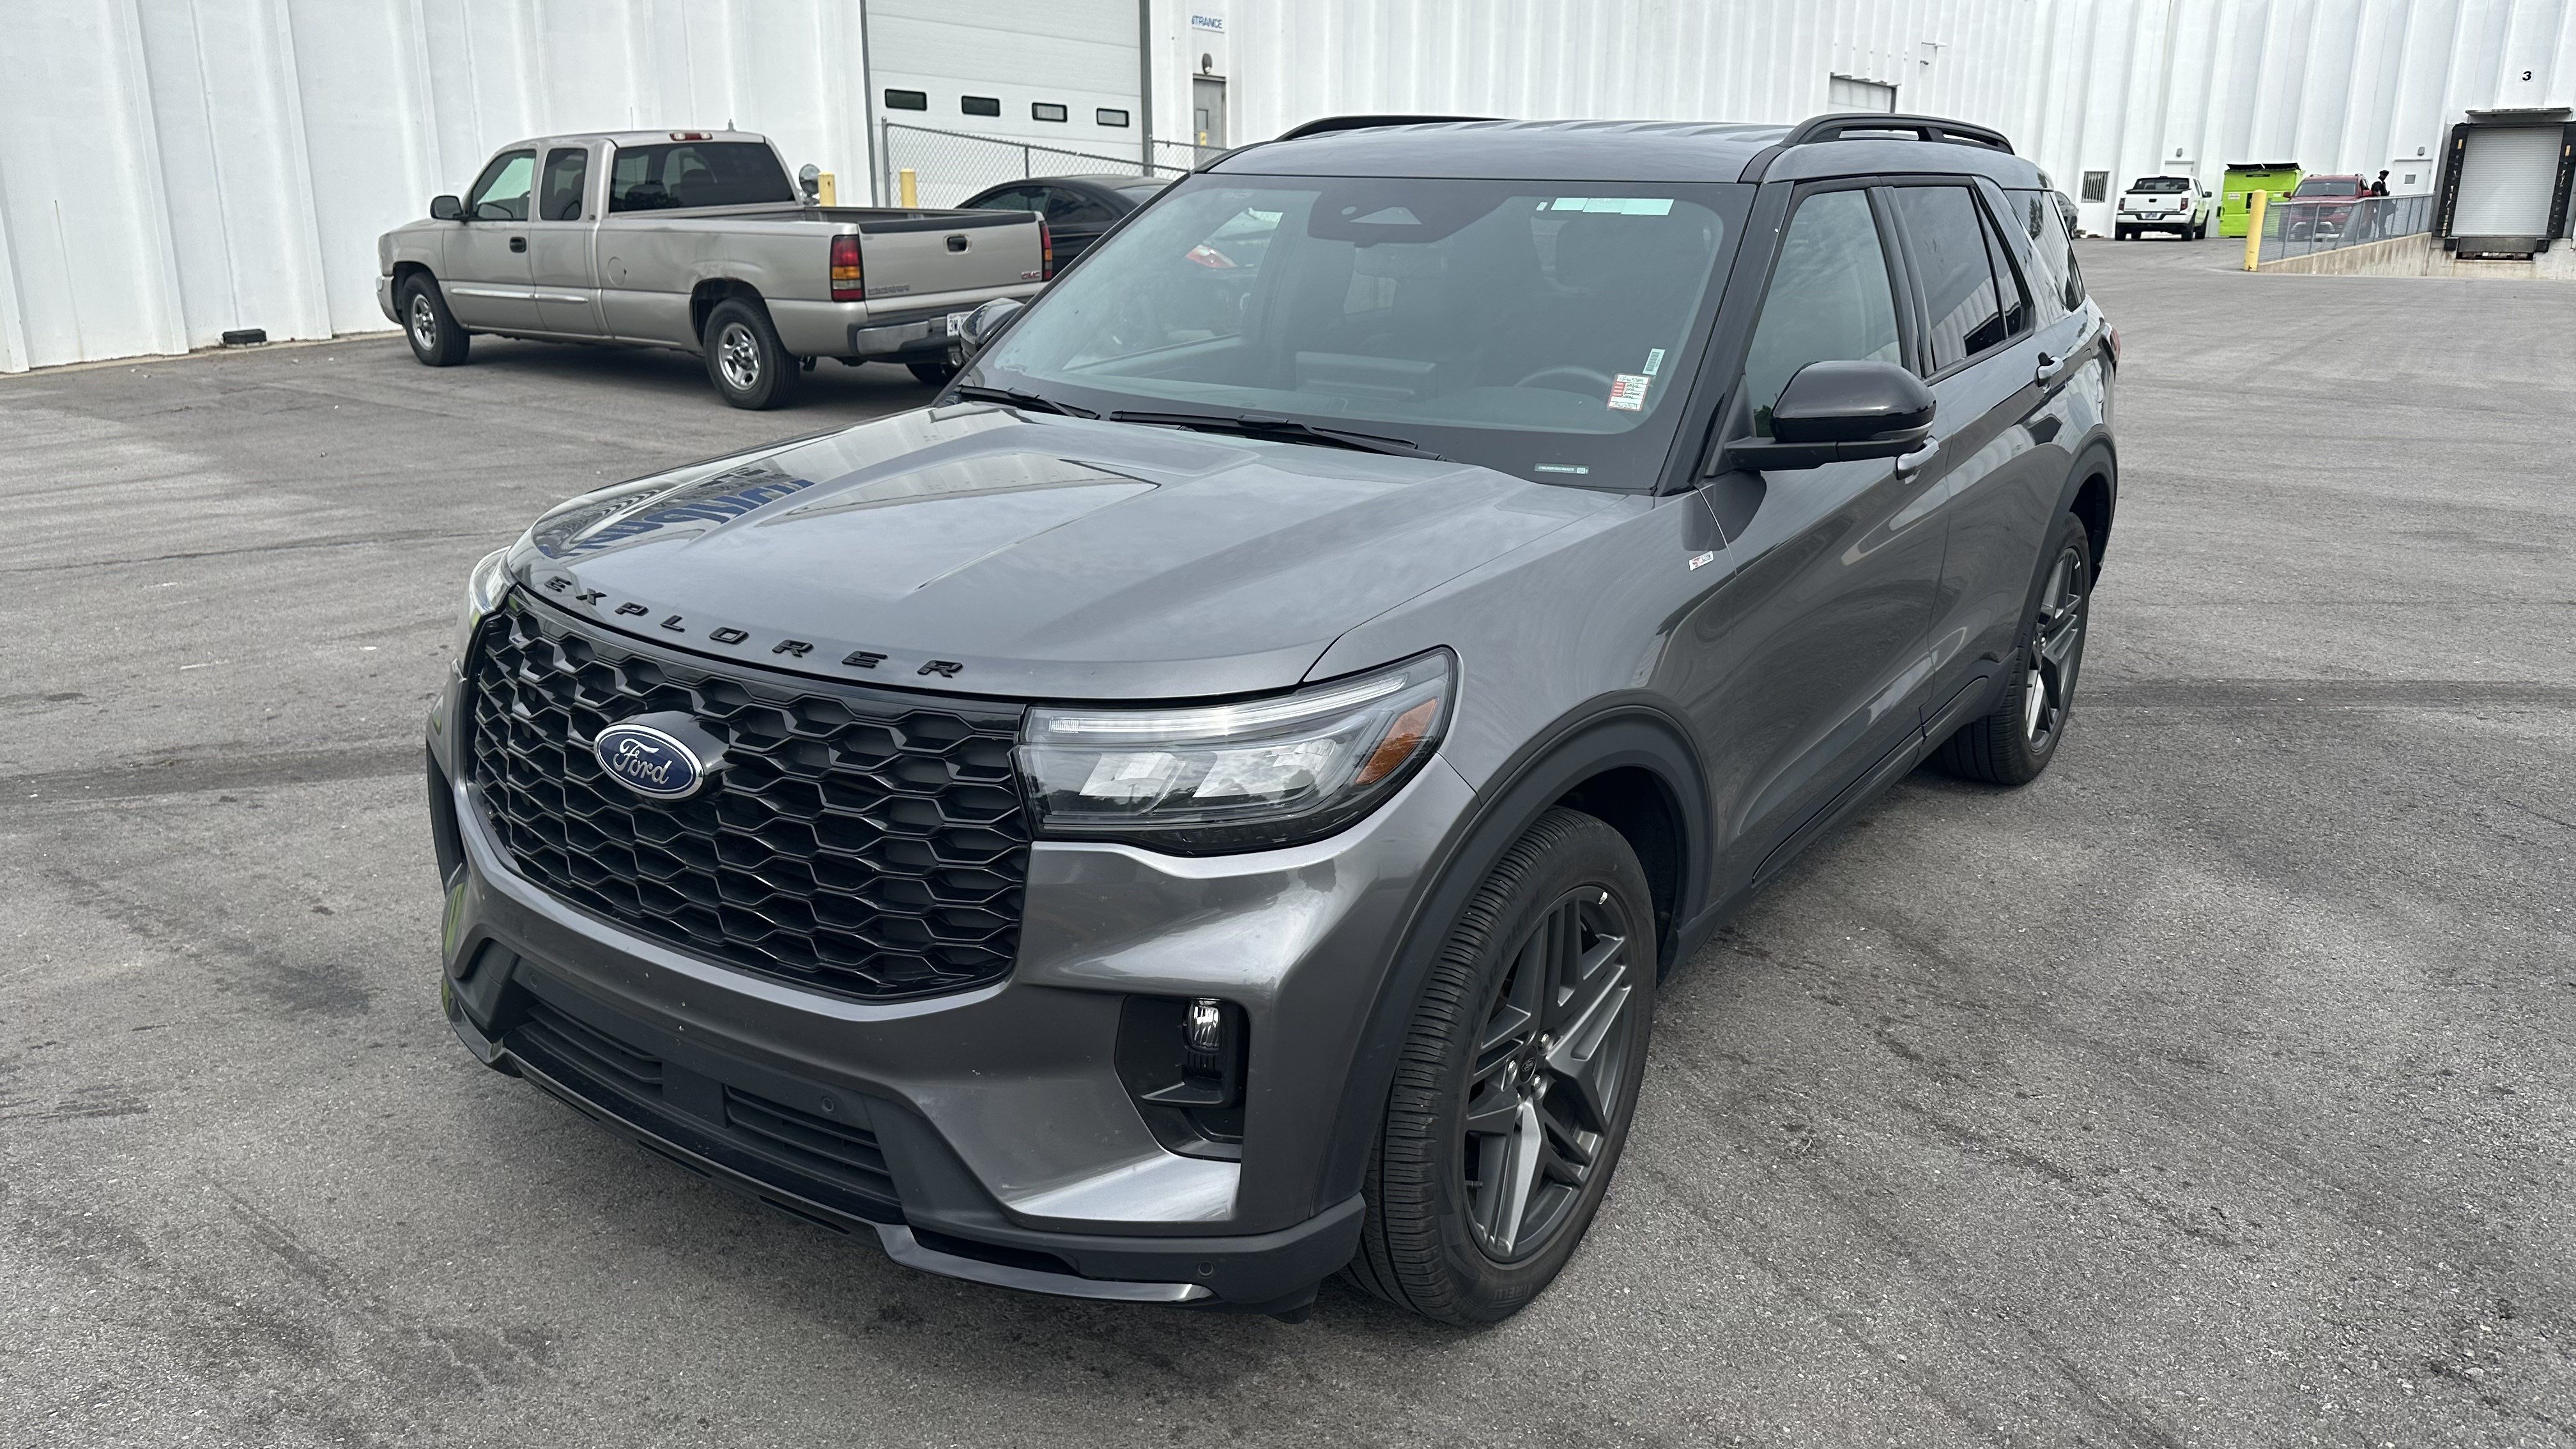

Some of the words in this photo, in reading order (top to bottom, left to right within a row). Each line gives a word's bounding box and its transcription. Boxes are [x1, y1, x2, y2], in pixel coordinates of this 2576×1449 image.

[2522, 70, 2532, 81] 3
[543, 575, 963, 678] EXPLORER
[612, 737, 673, 785] Ford
